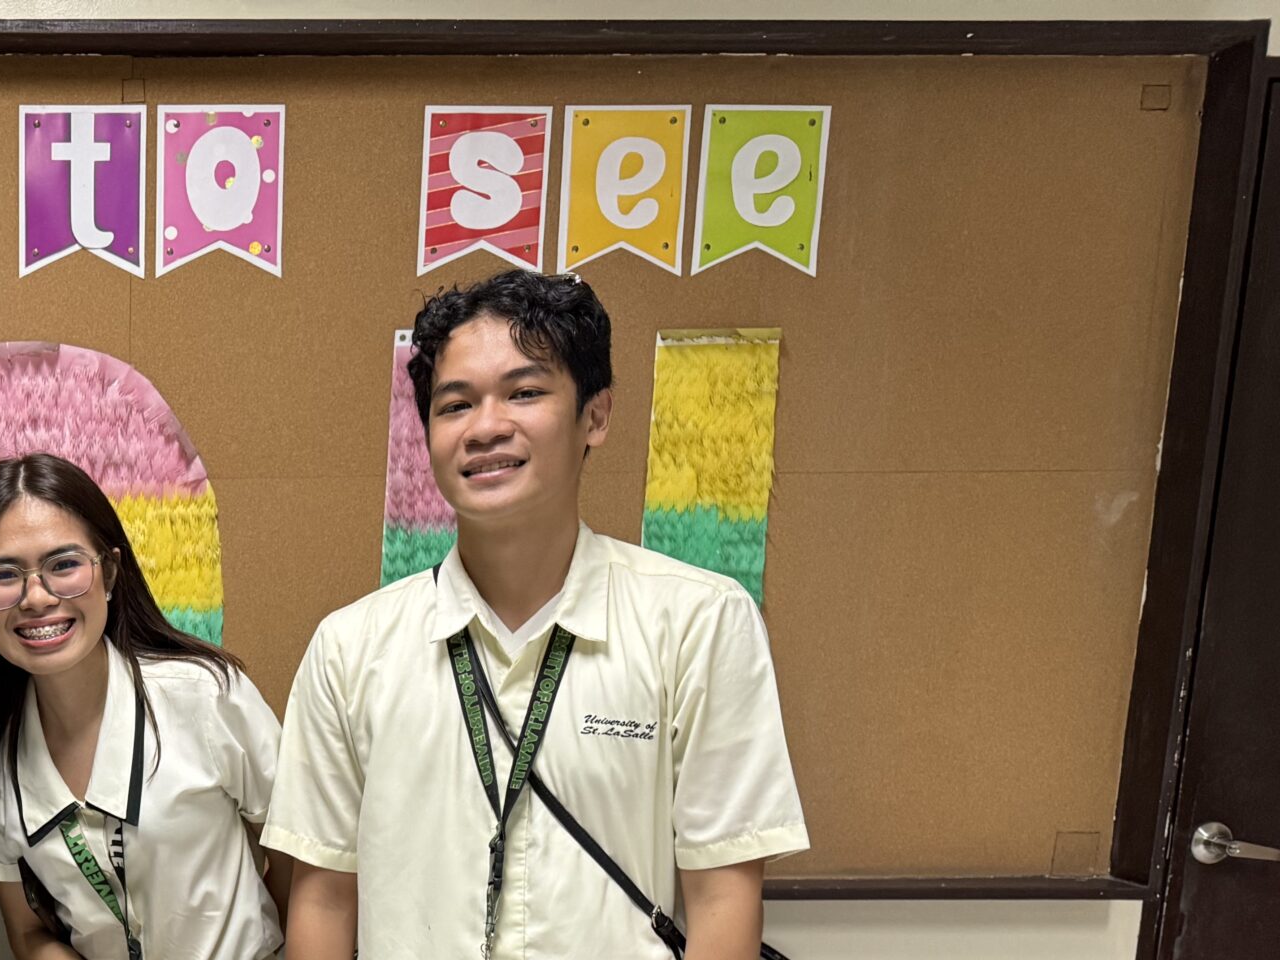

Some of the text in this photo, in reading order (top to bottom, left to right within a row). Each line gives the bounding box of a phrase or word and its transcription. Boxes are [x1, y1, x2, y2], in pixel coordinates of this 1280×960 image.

[50, 113, 262, 249] to
[448, 131, 803, 229] see
[463, 696, 493, 785] UNIVERSITY
[584, 714, 658, 733] University of
